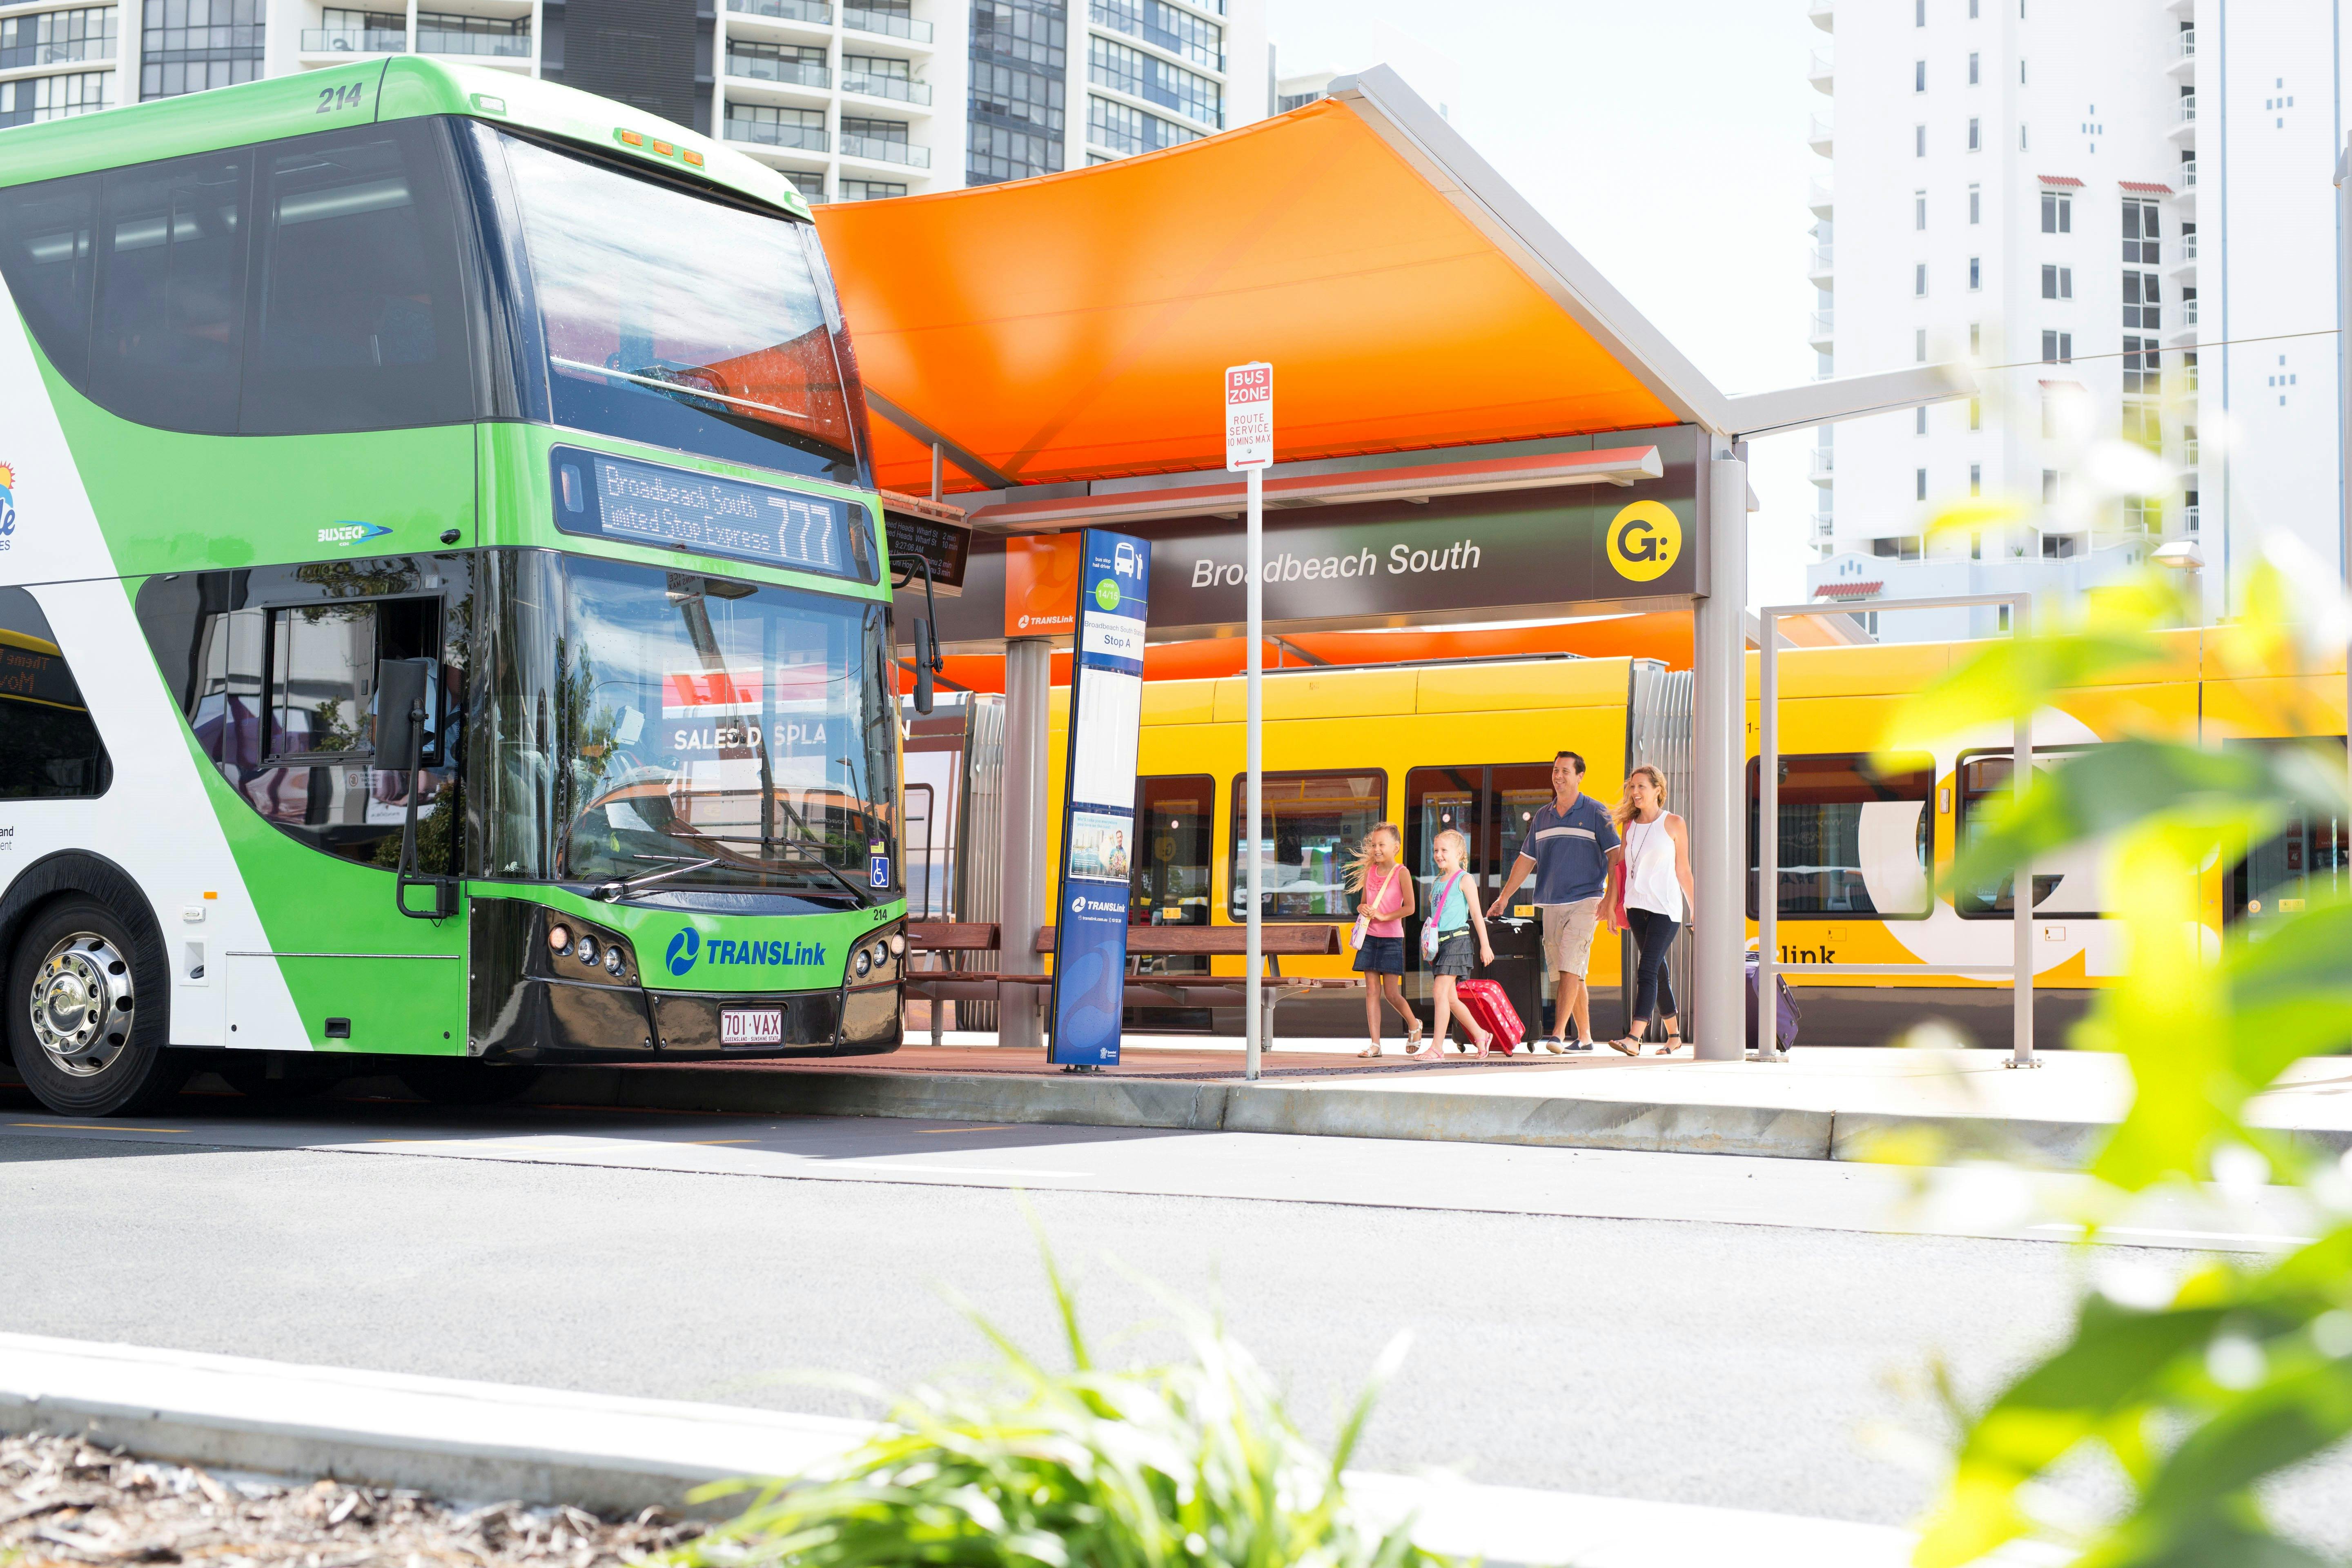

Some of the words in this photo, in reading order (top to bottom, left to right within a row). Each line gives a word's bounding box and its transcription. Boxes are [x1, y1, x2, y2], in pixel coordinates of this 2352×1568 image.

[316, 82, 363, 114] 214
[1234, 370, 1264, 386] BUS
[1229, 386, 1269, 403] ZONE
[1234, 413, 1264, 425] ROUTE
[1229, 423, 1269, 436] SERVICE
[1228, 438, 1234, 447] 10
[1237, 436, 1253, 445] MINS
[1256, 434, 1271, 443] MAX
[605, 465, 709, 510] Broadbeach
[712, 486, 757, 518] South
[599, 496, 659, 532] Limited
[664, 508, 701, 539] Stop
[704, 515, 770, 551] Express
[767, 496, 832, 565] 777
[898, 521, 914, 532] Heads
[917, 526, 933, 537] Wharf
[947, 534, 956, 542] min
[318, 526, 365, 542] BUSTECH
[897, 530, 913, 541] Heads
[915, 535, 931, 545] Wharf
[949, 542, 958, 551] min
[895, 541, 914, 551] 9:27:06
[938, 559, 942, 567] 2
[942, 560, 952, 569] min
[1191, 547, 1376, 588] Brodbeach
[1387, 539, 1481, 575] South
[941, 569, 951, 577] min
[1098, 590, 1118, 600] 14/15
[1031, 615, 1074, 625] TRANSLink
[1085, 621, 1119, 631] Broadbeach
[1120, 626, 1133, 634] South
[1104, 635, 1124, 648] Stop
[1125, 639, 1130, 648] A
[674, 728, 739, 751] SALES
[873, 909, 887, 921] 214
[1088, 901, 1125, 913] TRANSLink
[706, 940, 826, 966] TRANSLink
[725, 1014, 746, 1036] 701
[753, 1014, 780, 1036] VAX
